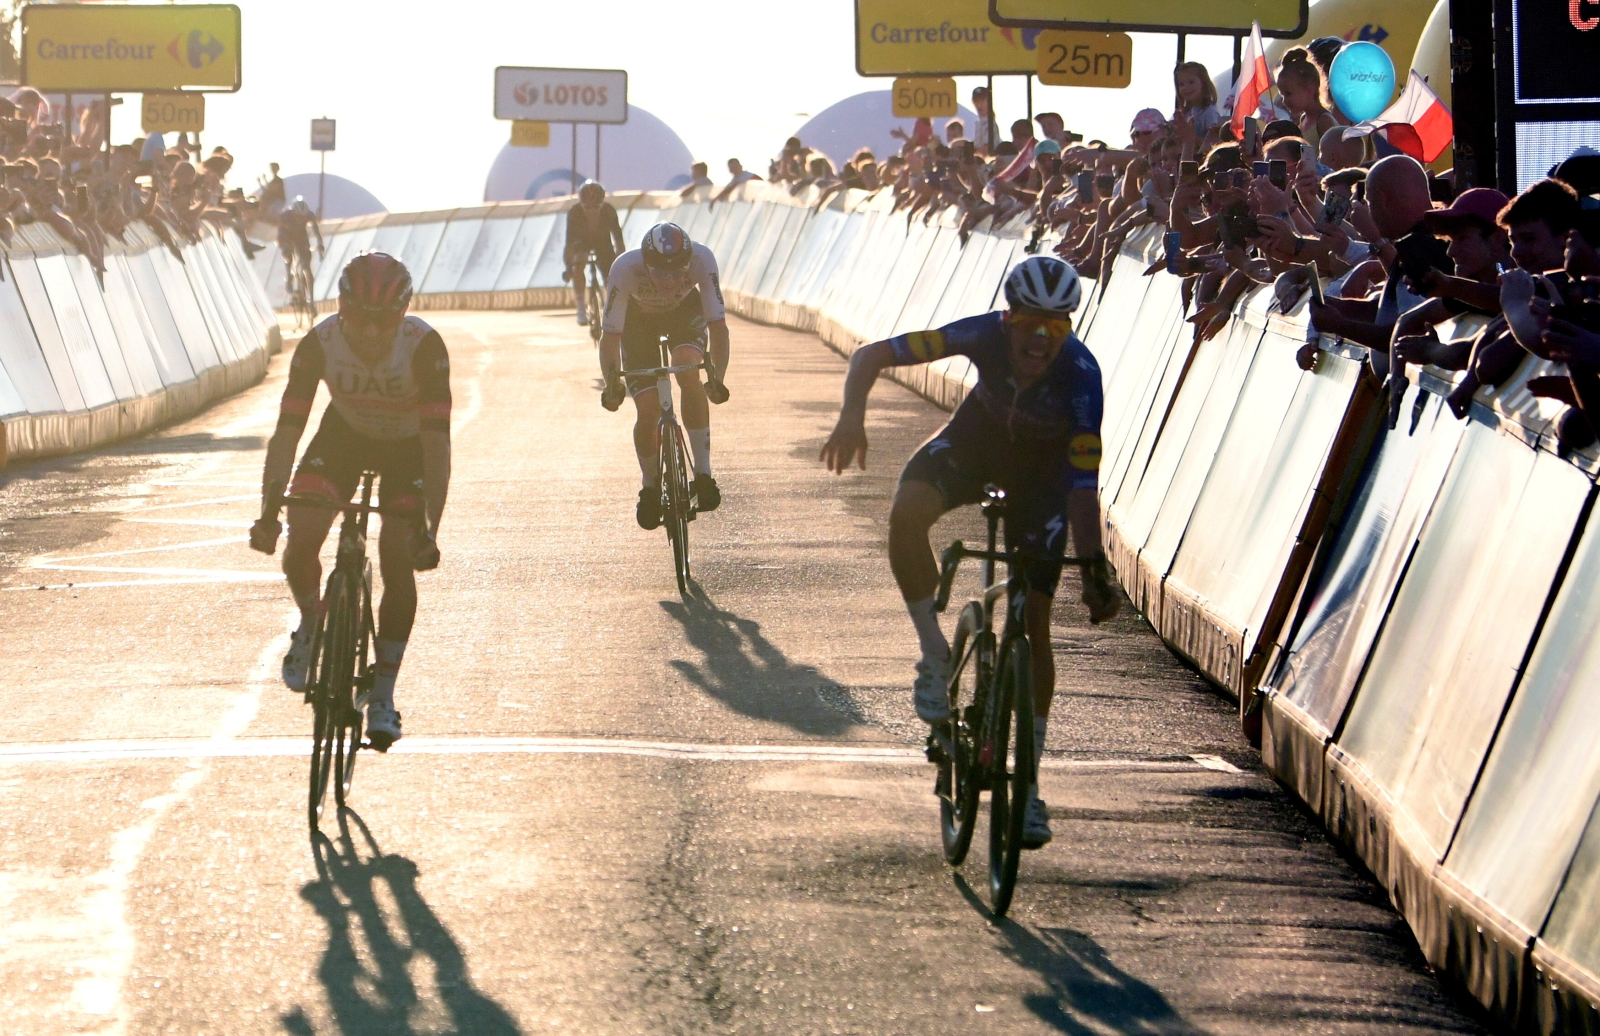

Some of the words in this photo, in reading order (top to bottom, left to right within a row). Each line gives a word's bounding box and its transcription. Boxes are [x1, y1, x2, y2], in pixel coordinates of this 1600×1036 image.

[870, 21, 990, 45] Carrefour
[37, 38, 156, 61] Carrefour
[1046, 43, 1124, 77] 25m
[543, 82, 608, 107] LOTOS
[897, 87, 951, 110] 50m
[145, 102, 199, 125] 50m
[335, 371, 406, 399] UAE
